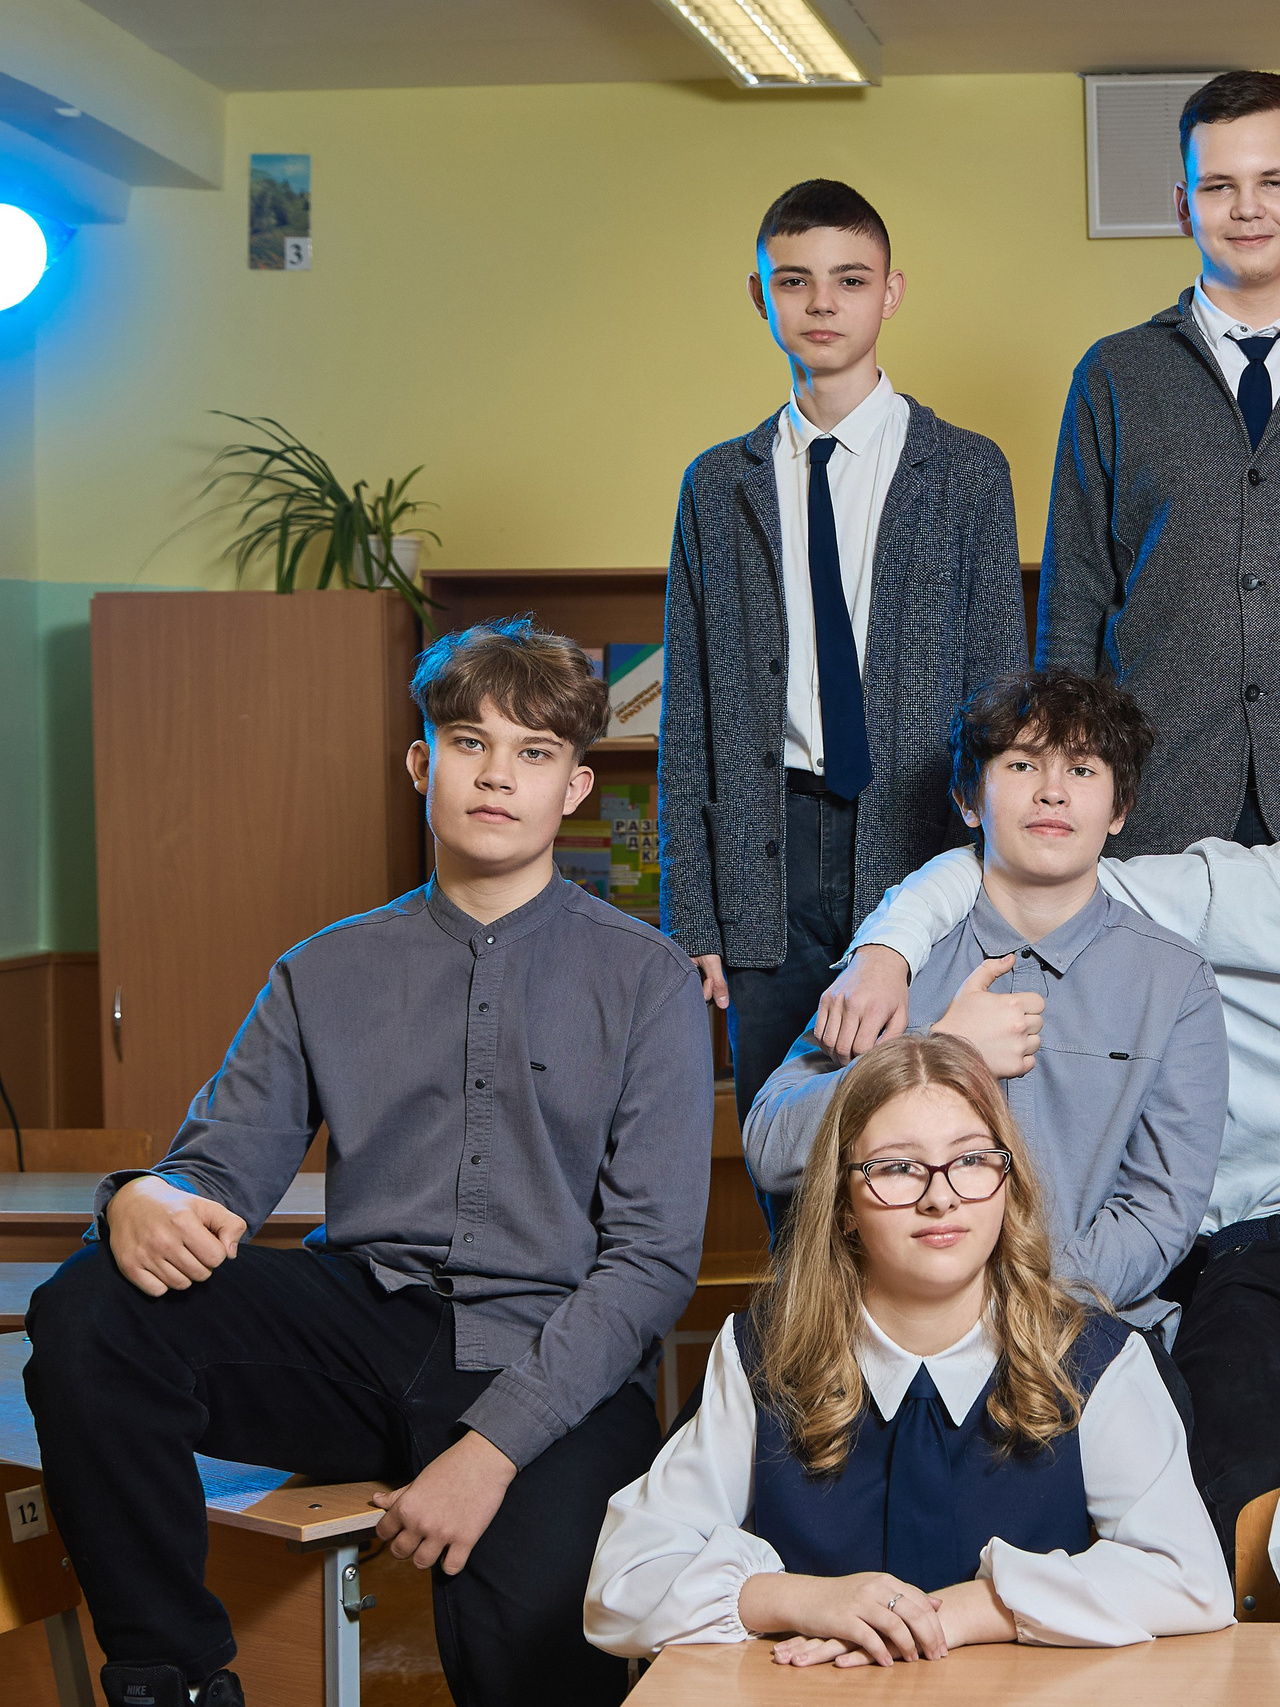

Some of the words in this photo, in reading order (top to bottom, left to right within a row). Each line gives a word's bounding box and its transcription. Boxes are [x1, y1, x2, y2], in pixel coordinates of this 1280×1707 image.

[289, 243, 303, 265] 3
[18, 1502, 39, 1525] 12
[127, 1685, 147, 1696] NIKE
